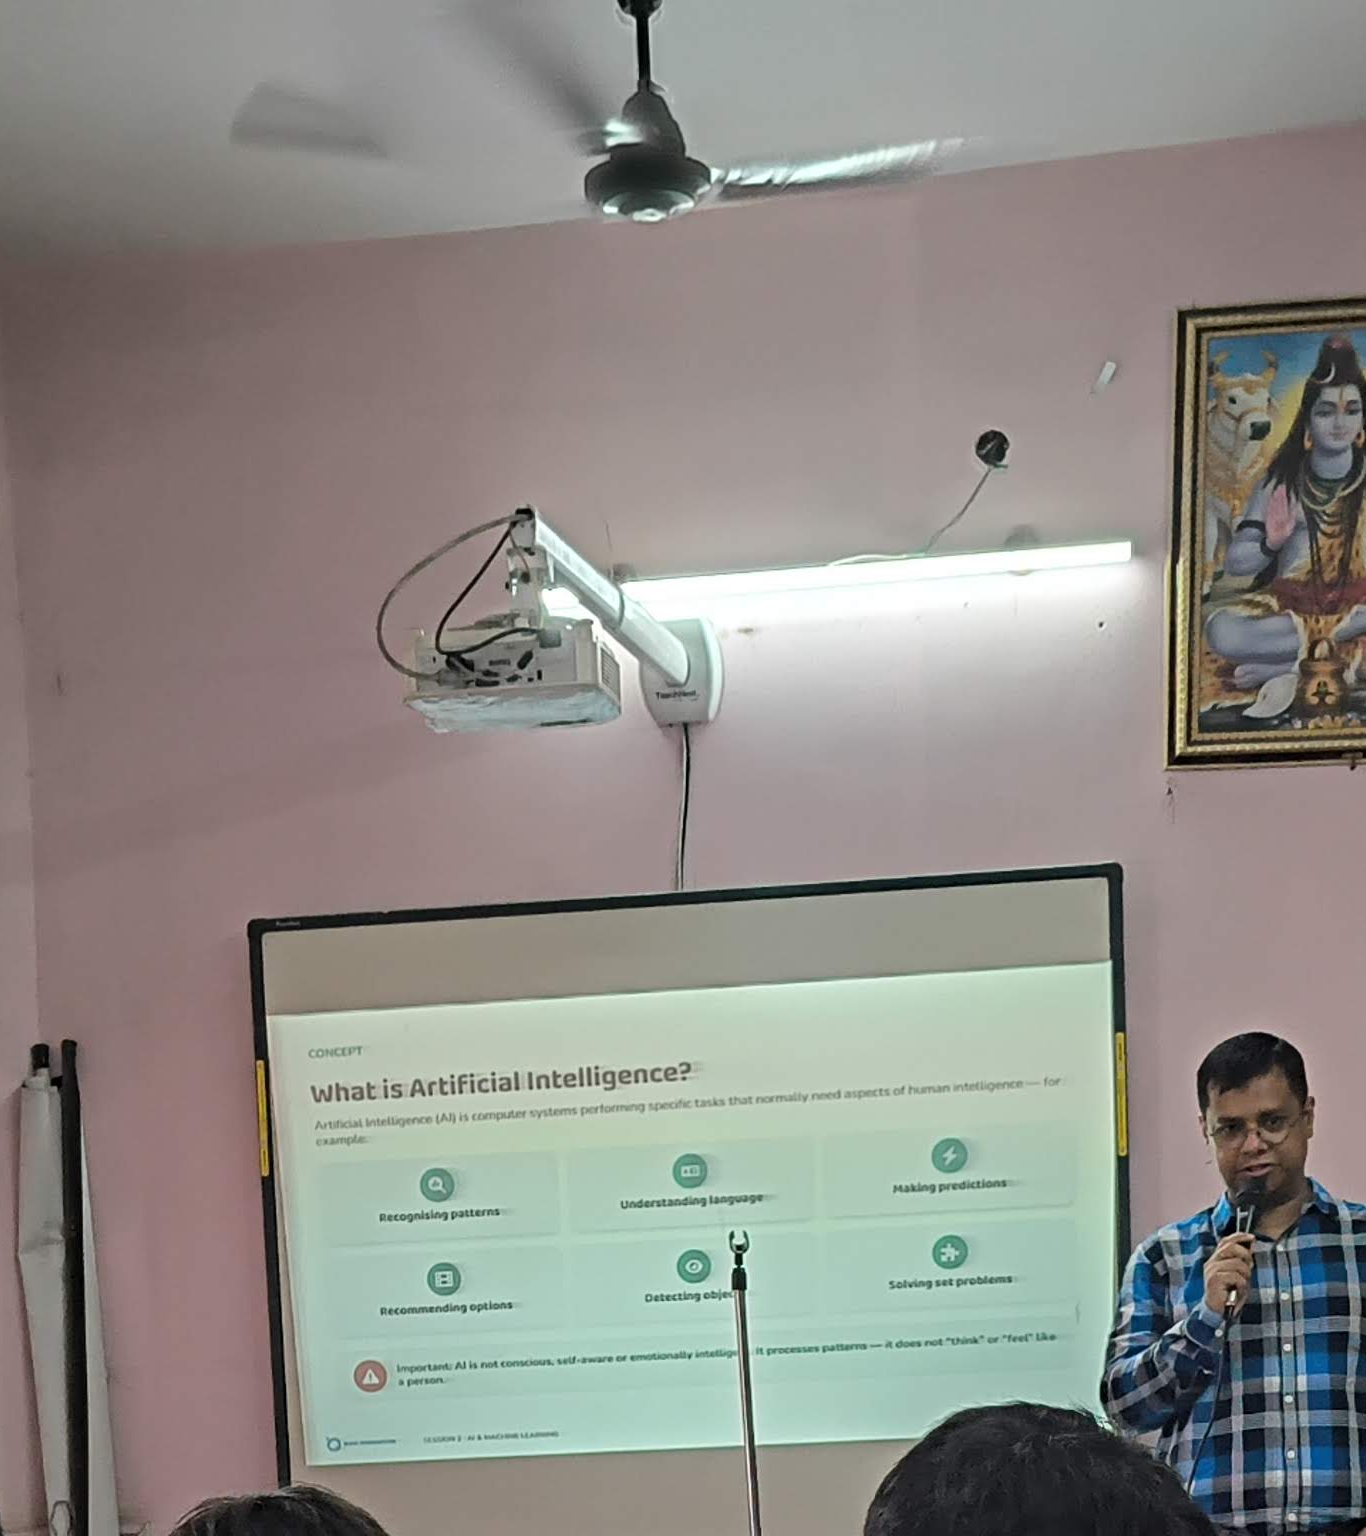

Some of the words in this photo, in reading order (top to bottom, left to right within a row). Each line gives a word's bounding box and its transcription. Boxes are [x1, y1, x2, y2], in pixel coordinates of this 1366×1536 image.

[308, 1045, 364, 1059] CONCEPT
[310, 1081, 377, 1104] What
[382, 1078, 404, 1100] is
[409, 1070, 521, 1098] Artificial
[527, 1060, 693, 1091] Intelligence?
[314, 1119, 363, 1131] Artificial
[365, 1114, 433, 1129] Intelligence
[435, 1111, 457, 1125] (AI)
[459, 1111, 470, 1122] is
[471, 1109, 527, 1123] computer
[529, 1105, 578, 1119] systems
[579, 1101, 646, 1118] performing
[648, 1098, 692, 1113] specific
[694, 1096, 726, 1109] tasks
[728, 1094, 754, 1106] that
[756, 1091, 809, 1105] normally
[812, 1088, 841, 1101] need
[843, 1086, 891, 1101] aspects
[892, 1084, 906, 1096] of
[908, 1083, 951, 1096] human
[952, 1077, 1024, 1094] intelligence
[1043, 1076, 1062, 1088] for
[315, 1134, 368, 1148] example:
[892, 1181, 937, 1195] Making
[938, 1177, 1008, 1193] predictions
[620, 1196, 708, 1210] Understanding
[709, 1193, 764, 1206] language
[379, 1208, 449, 1224] Recognising
[450, 1207, 501, 1221] patterns
[888, 1276, 933, 1290] Solving
[934, 1277, 954, 1288] set
[955, 1273, 1013, 1288] problems
[644, 1290, 701, 1303] Detecting
[703, 1288, 734, 1301] objec
[380, 1302, 468, 1316] Recommending
[469, 1300, 514, 1313] options
[397, 1361, 453, 1374] Important:
[454, 1360, 467, 1371] AI
[469, 1360, 478, 1370] is
[480, 1360, 499, 1370] not
[500, 1357, 555, 1369] conscious,
[556, 1355, 614, 1367] self-aware
[615, 1354, 628, 1364] or
[629, 1350, 693, 1362] emotionally
[694, 1347, 739, 1360] intellige
[766, 1345, 820, 1357] processes
[821, 1343, 868, 1354] patterns
[884, 1339, 894, 1350] it
[895, 1338, 922, 1349] does
[924, 1337, 943, 1348] not
[987, 1335, 1000, 1345] or
[1036, 1331, 1057, 1343] like
[398, 1378, 405, 1387] a
[406, 1376, 446, 1388] person.
